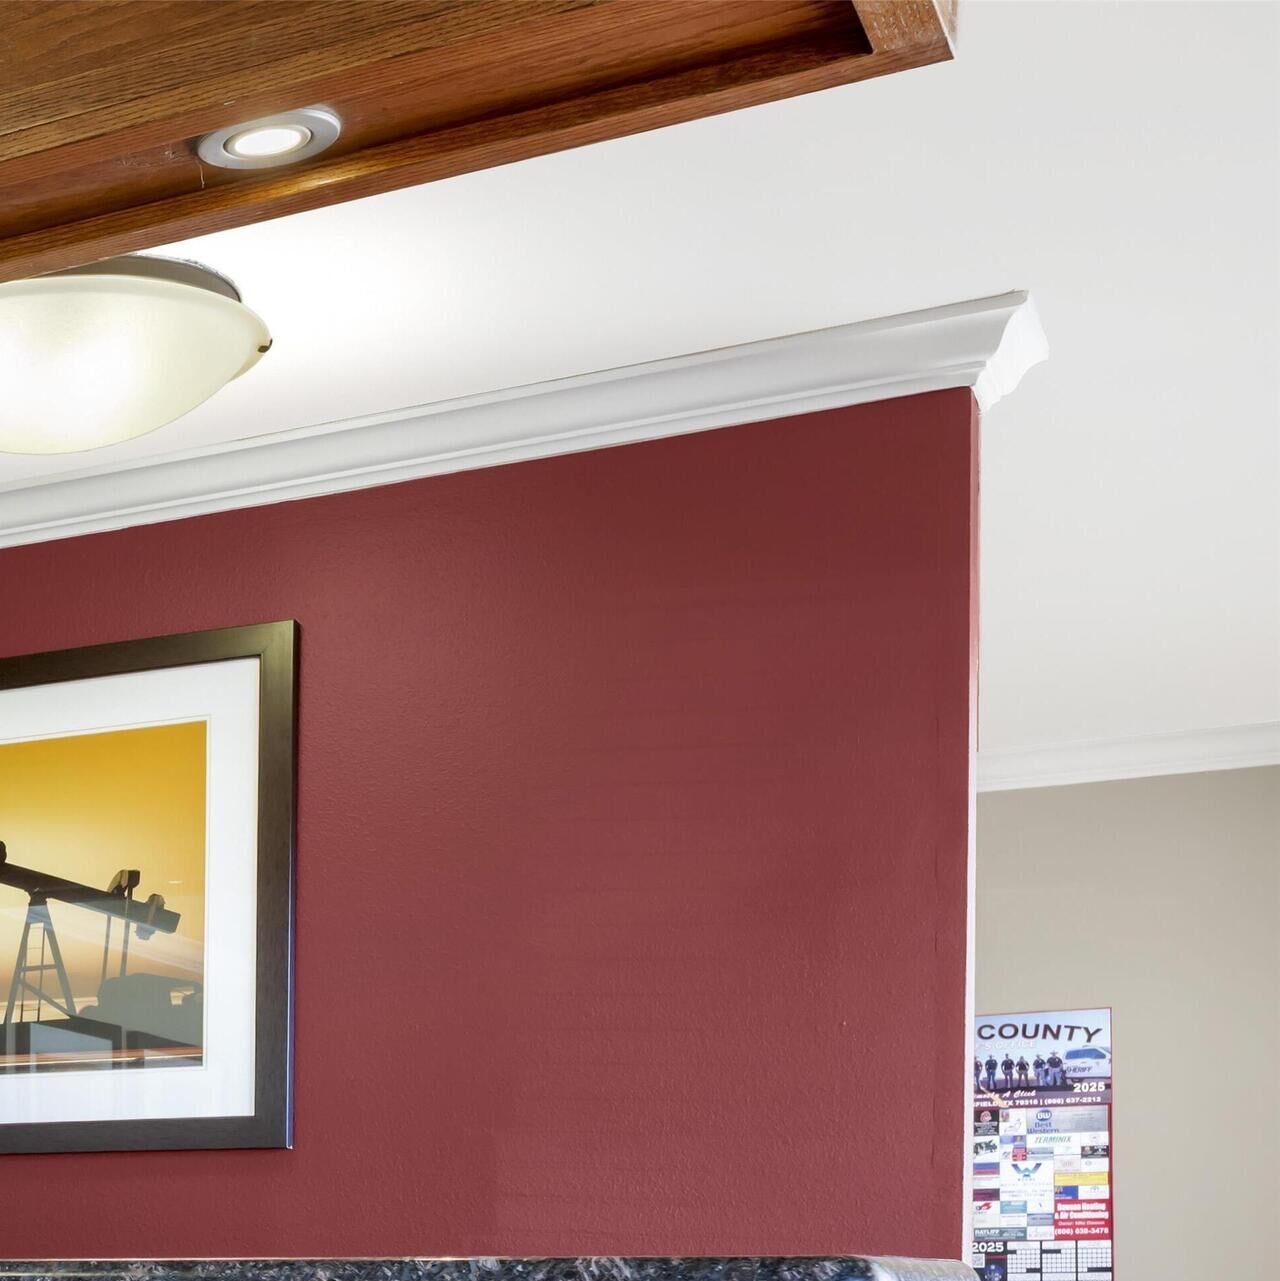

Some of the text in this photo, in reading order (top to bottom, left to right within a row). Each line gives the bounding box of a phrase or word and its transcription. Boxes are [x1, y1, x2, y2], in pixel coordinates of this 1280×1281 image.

[977, 1023, 1103, 1043] COUNTY
[1073, 1082, 1106, 1093] 2025
[972, 1242, 1004, 1253] 2025
